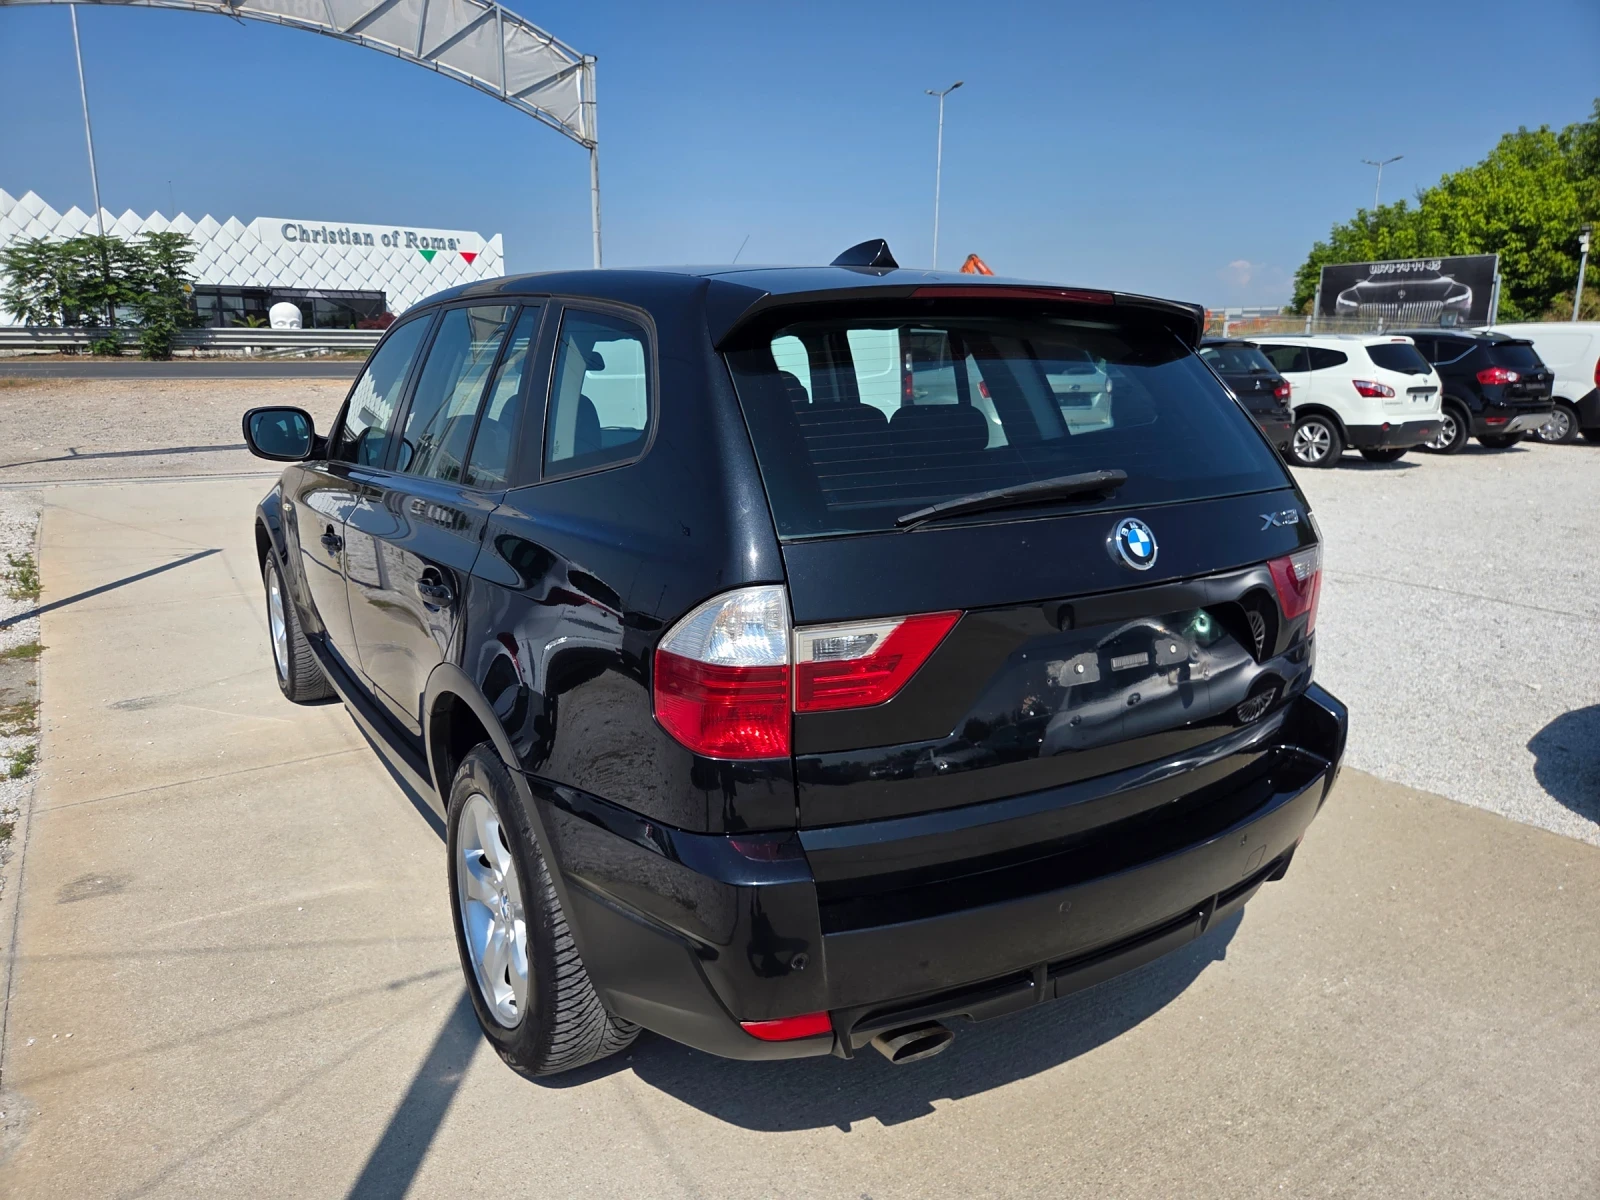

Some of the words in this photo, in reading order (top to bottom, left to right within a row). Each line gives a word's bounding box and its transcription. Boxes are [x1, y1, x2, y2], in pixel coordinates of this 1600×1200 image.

[281, 223, 375, 247] Christian
[380, 230, 400, 248] of
[1258, 508, 1299, 532] X3
